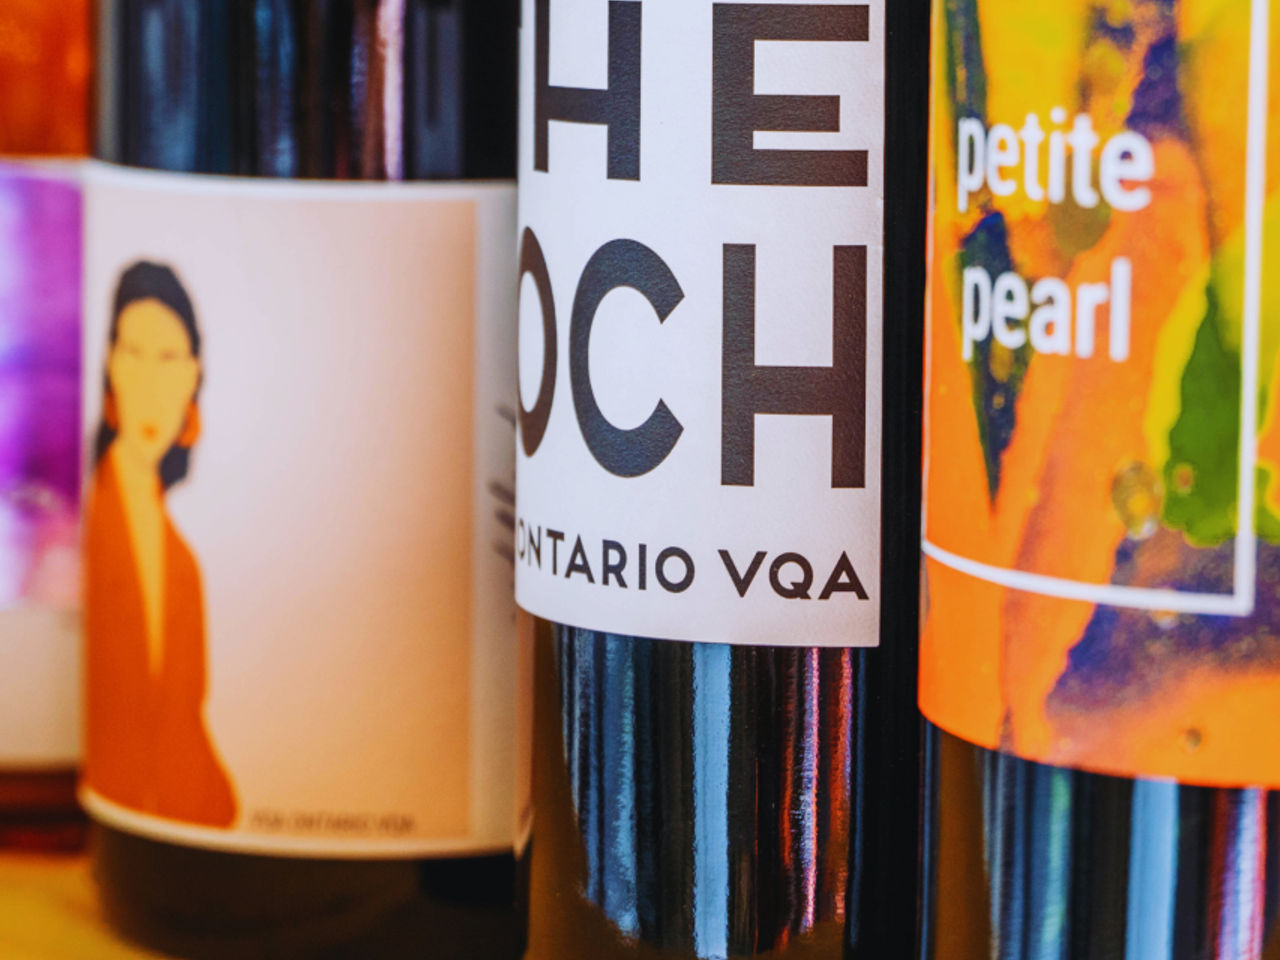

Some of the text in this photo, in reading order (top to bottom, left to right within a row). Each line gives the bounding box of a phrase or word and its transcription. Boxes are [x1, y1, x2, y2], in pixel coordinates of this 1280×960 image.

[957, 106, 1154, 213] petite
[962, 255, 1132, 362] pearl
[518, 518, 870, 601] ONTARIO VQA
